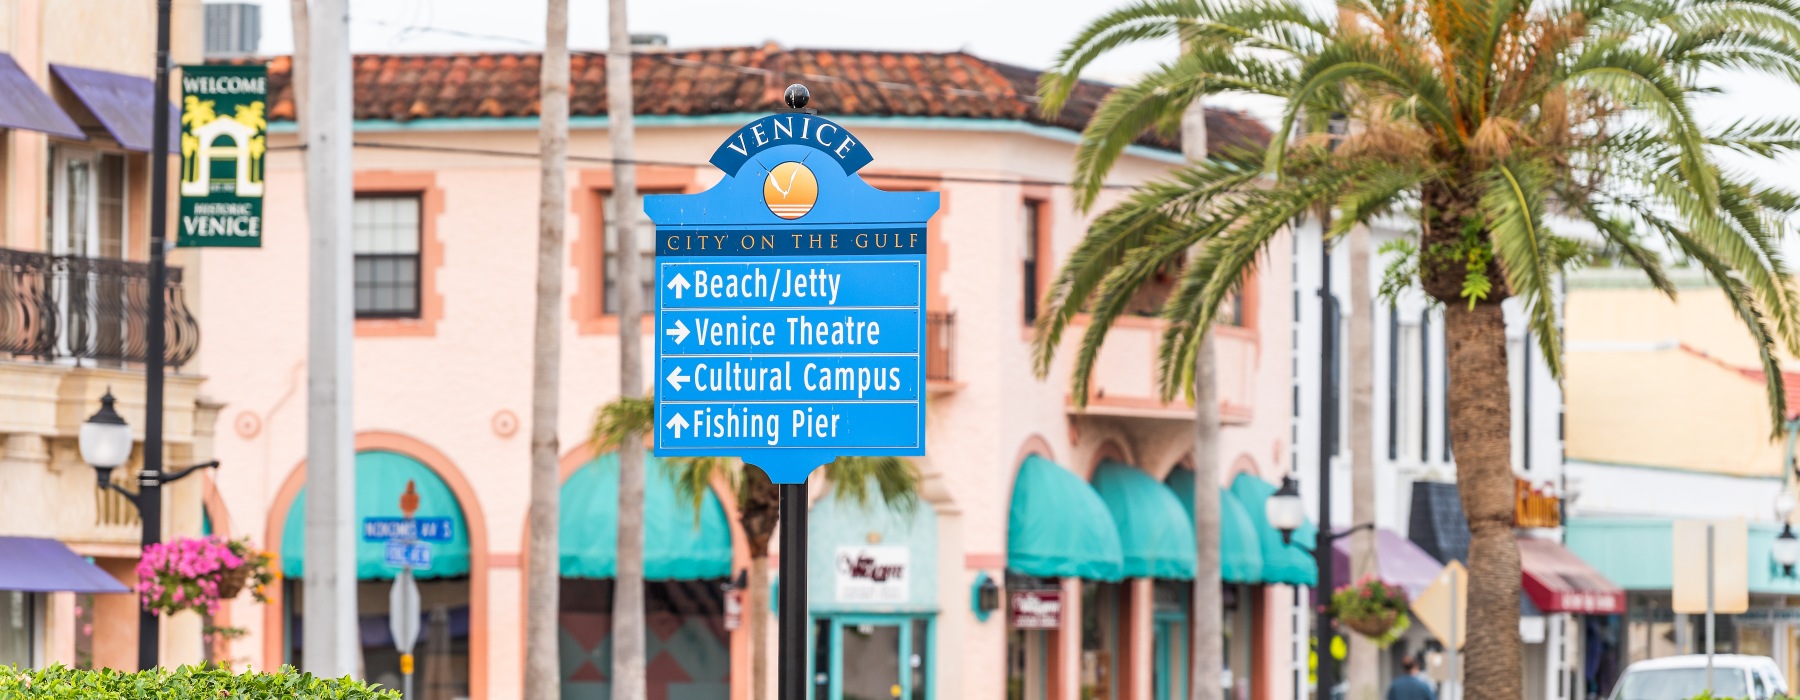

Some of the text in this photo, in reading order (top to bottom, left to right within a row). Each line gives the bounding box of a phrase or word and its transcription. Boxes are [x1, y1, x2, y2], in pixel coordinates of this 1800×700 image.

[183, 76, 266, 95] WELCOME
[727, 116, 857, 160] VENICE
[183, 216, 261, 238] VENICE
[667, 232, 918, 251] CITY ON THE GULF
[694, 267, 841, 306] Beach/Jetty
[695, 313, 880, 346] Venice Theatre
[693, 361, 901, 399] Cultural Campus
[693, 406, 840, 446] Fishing Pier
